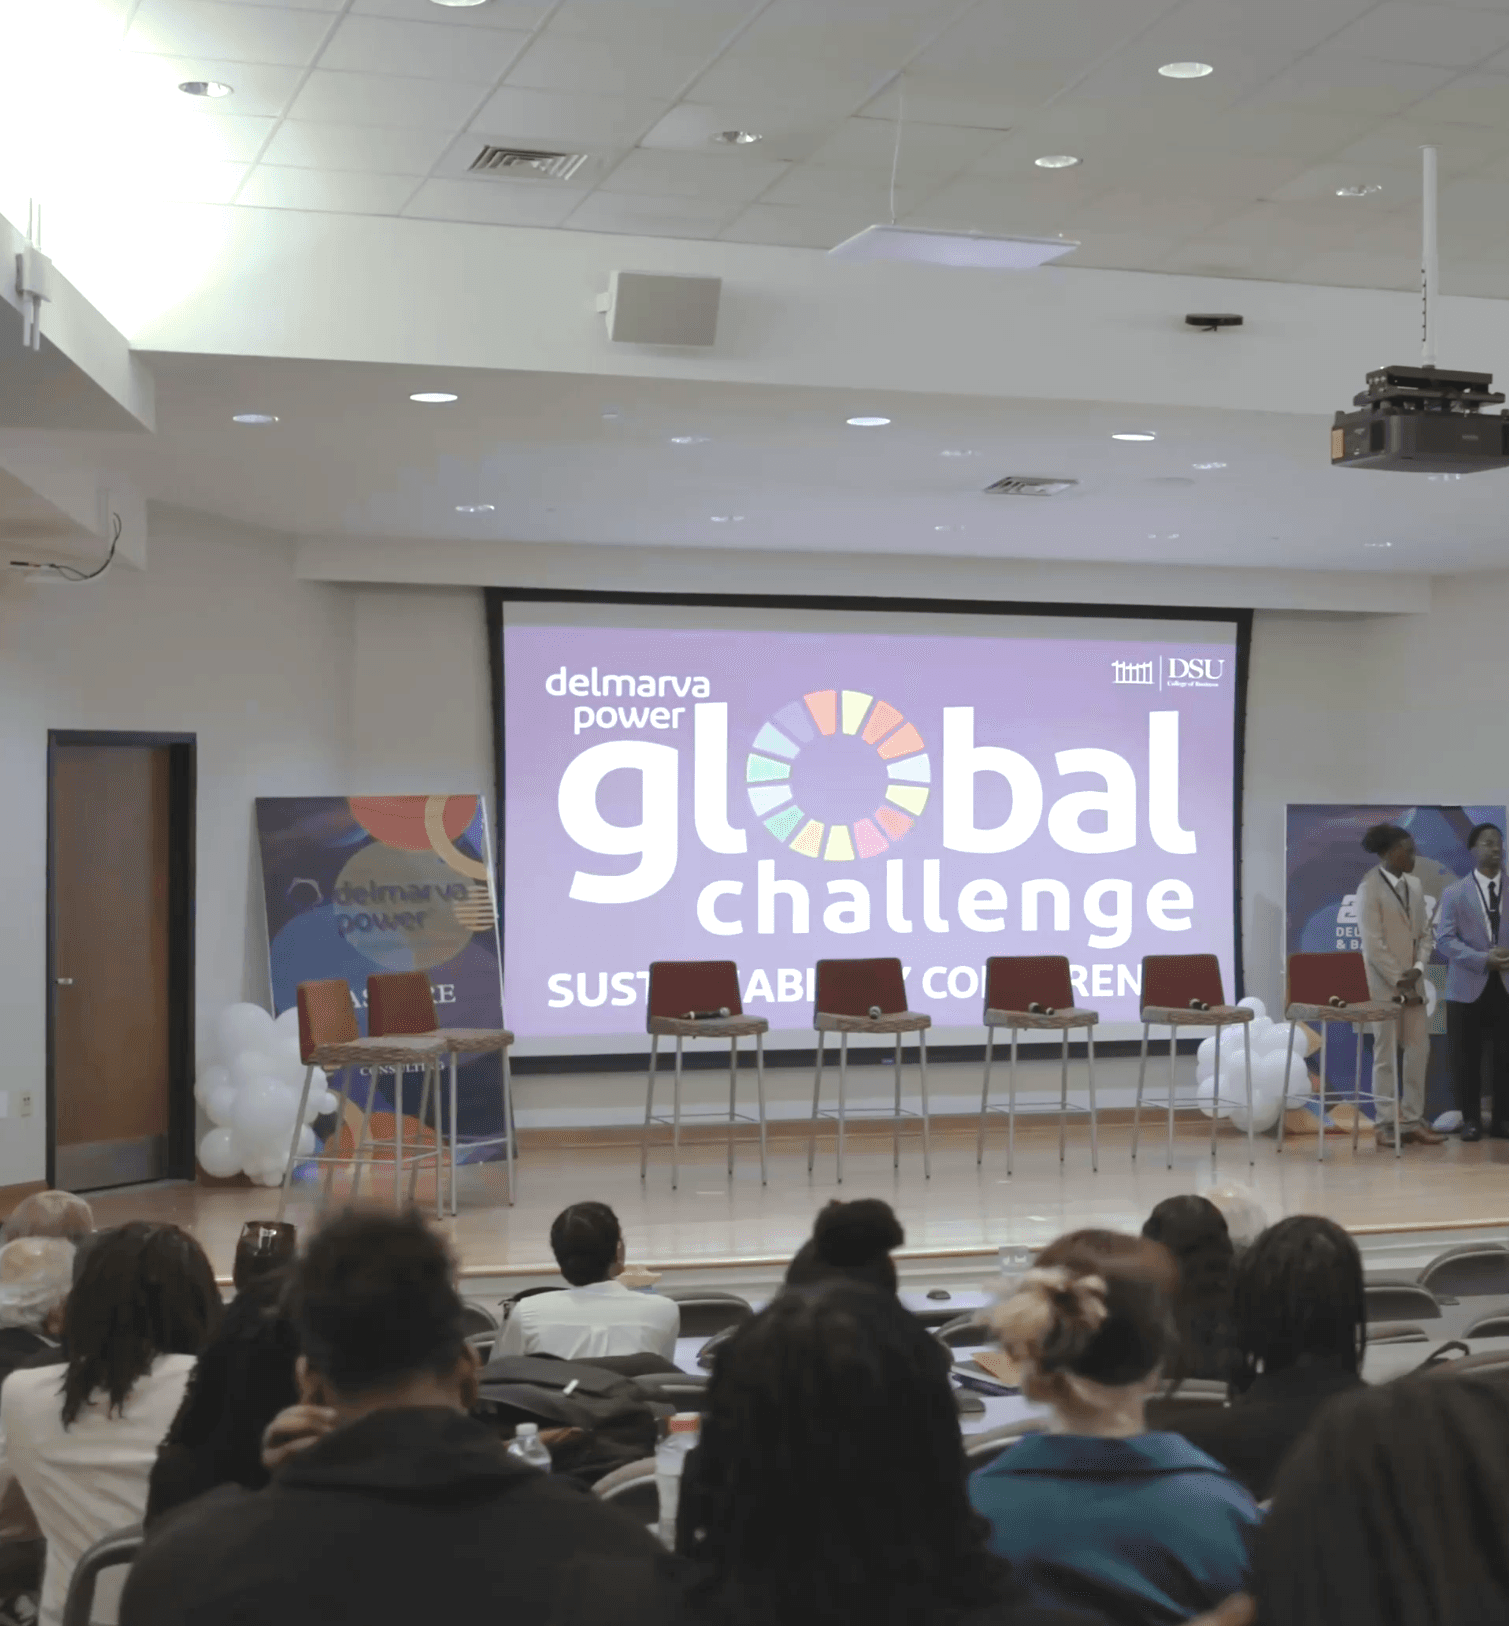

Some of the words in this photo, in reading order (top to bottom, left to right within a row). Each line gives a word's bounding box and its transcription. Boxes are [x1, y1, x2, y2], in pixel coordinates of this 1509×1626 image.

[545, 666, 710, 698] delmarva
[1168, 657, 1225, 680] DSU
[574, 706, 686, 735] power
[557, 690, 1197, 904] global
[332, 879, 470, 907] delmarva
[696, 858, 1194, 950] challenge
[336, 911, 428, 939] power
